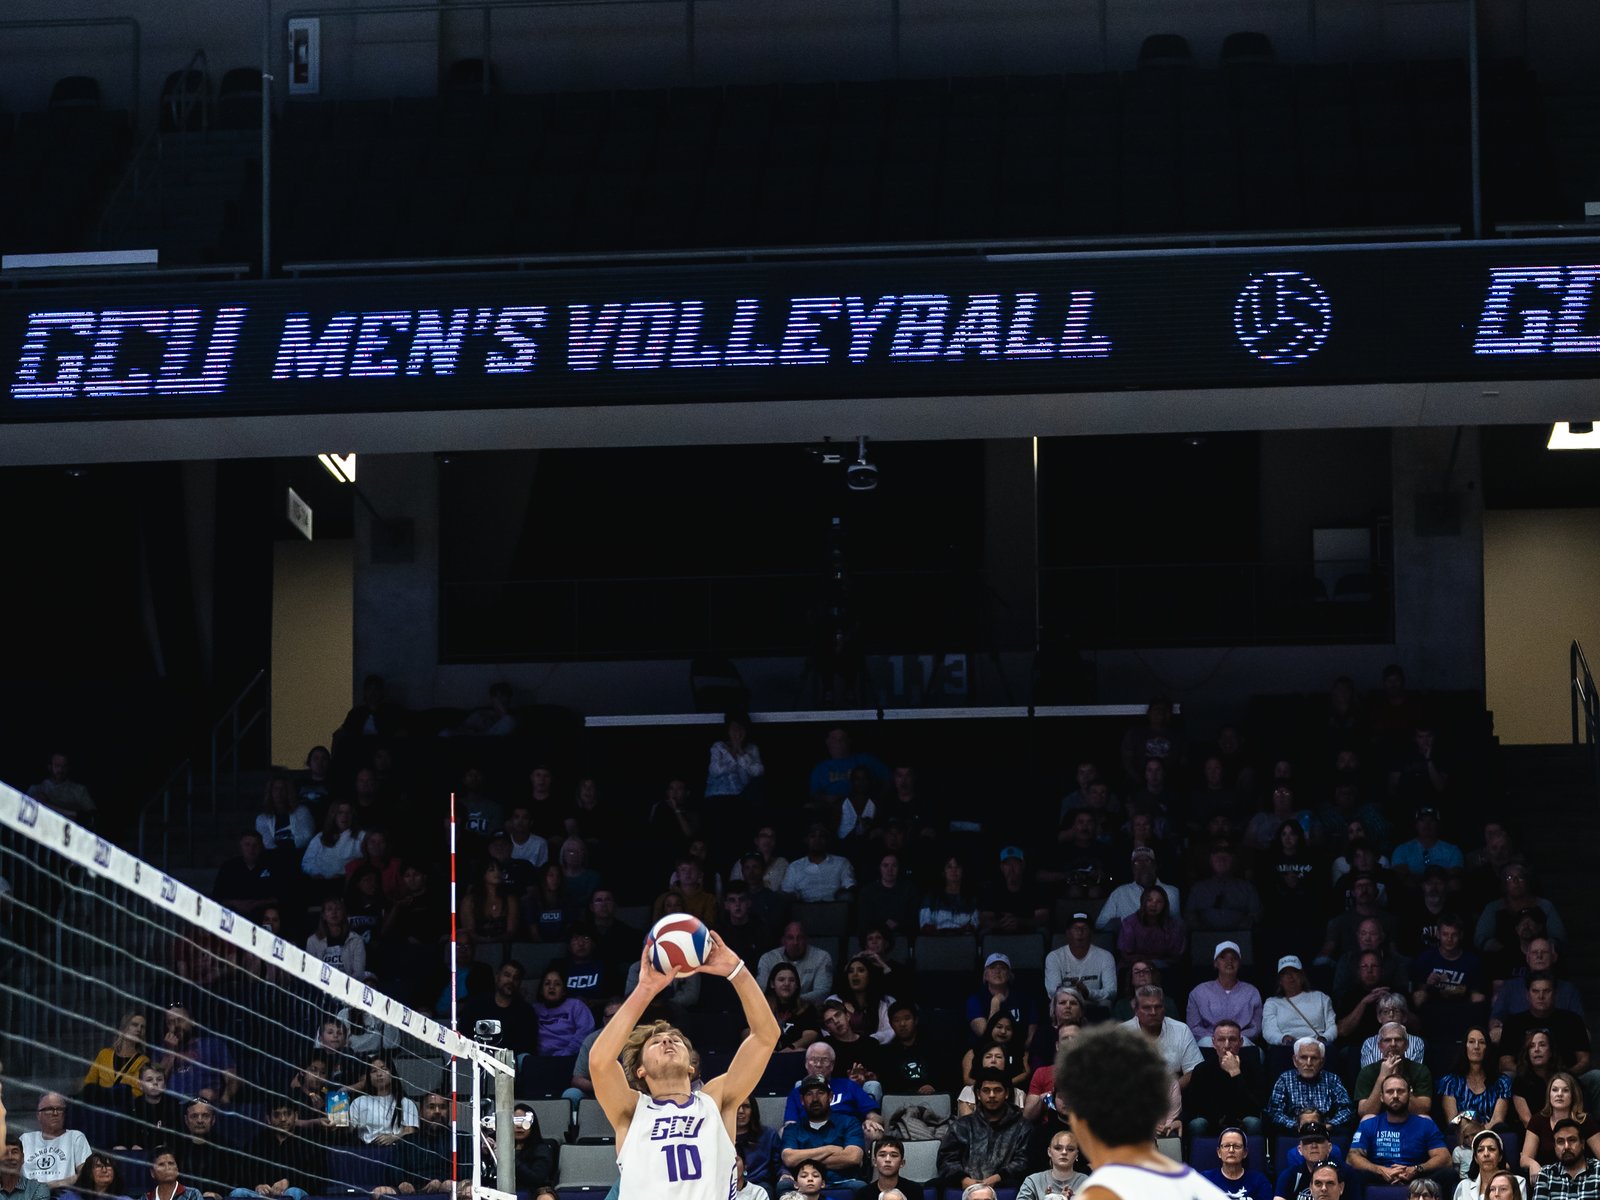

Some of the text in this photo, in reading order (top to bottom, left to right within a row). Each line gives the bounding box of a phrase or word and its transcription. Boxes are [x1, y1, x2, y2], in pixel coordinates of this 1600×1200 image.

[10, 290, 1112, 399] GCU MEN'S VOLLEYBALL
[542, 912, 561, 921] GCU
[567, 973, 599, 989] GCU
[650, 1115, 706, 1141] GCU
[1381, 1130, 1401, 1139] STAND
[661, 1143, 704, 1183] 10
